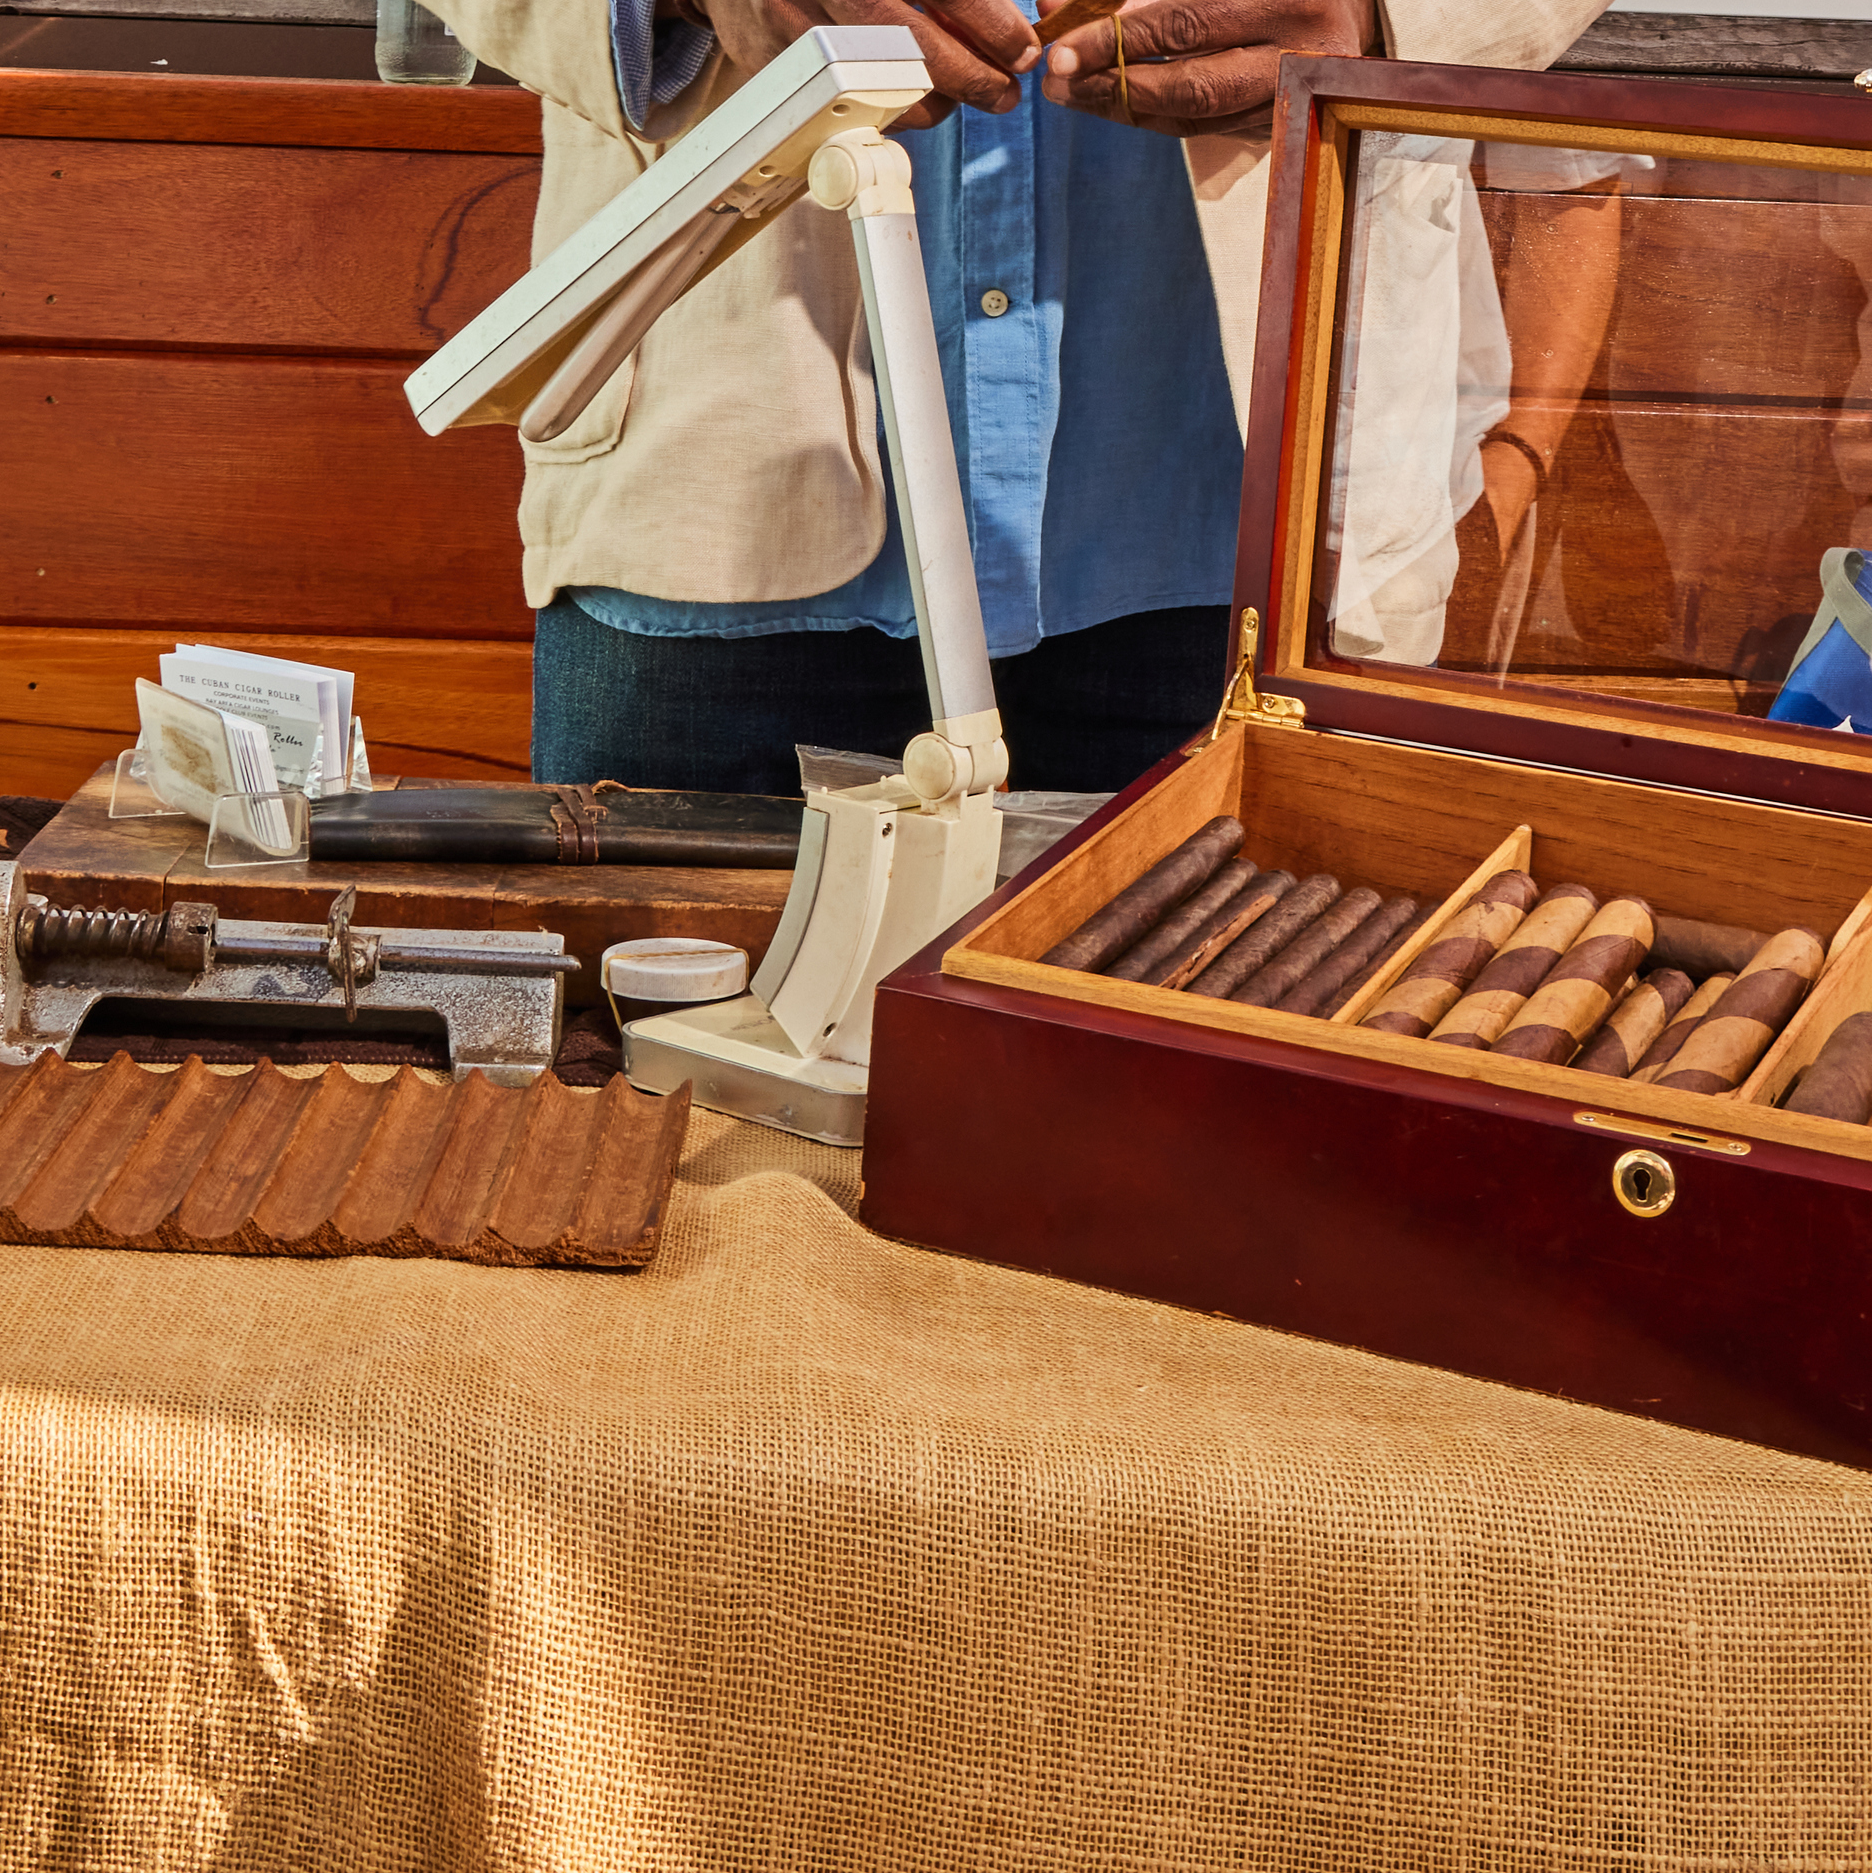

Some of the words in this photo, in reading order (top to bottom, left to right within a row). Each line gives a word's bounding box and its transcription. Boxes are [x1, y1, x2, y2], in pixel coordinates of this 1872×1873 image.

[179, 674, 196, 685] THE
[202, 678, 230, 690] CUBAN
[235, 683, 263, 695] CIGAR
[268, 689, 301, 702] ROLLER
[213, 691, 247, 702] CORPORATE
[248, 697, 270, 706] EVENTS
[234, 702, 251, 710] CIGAR
